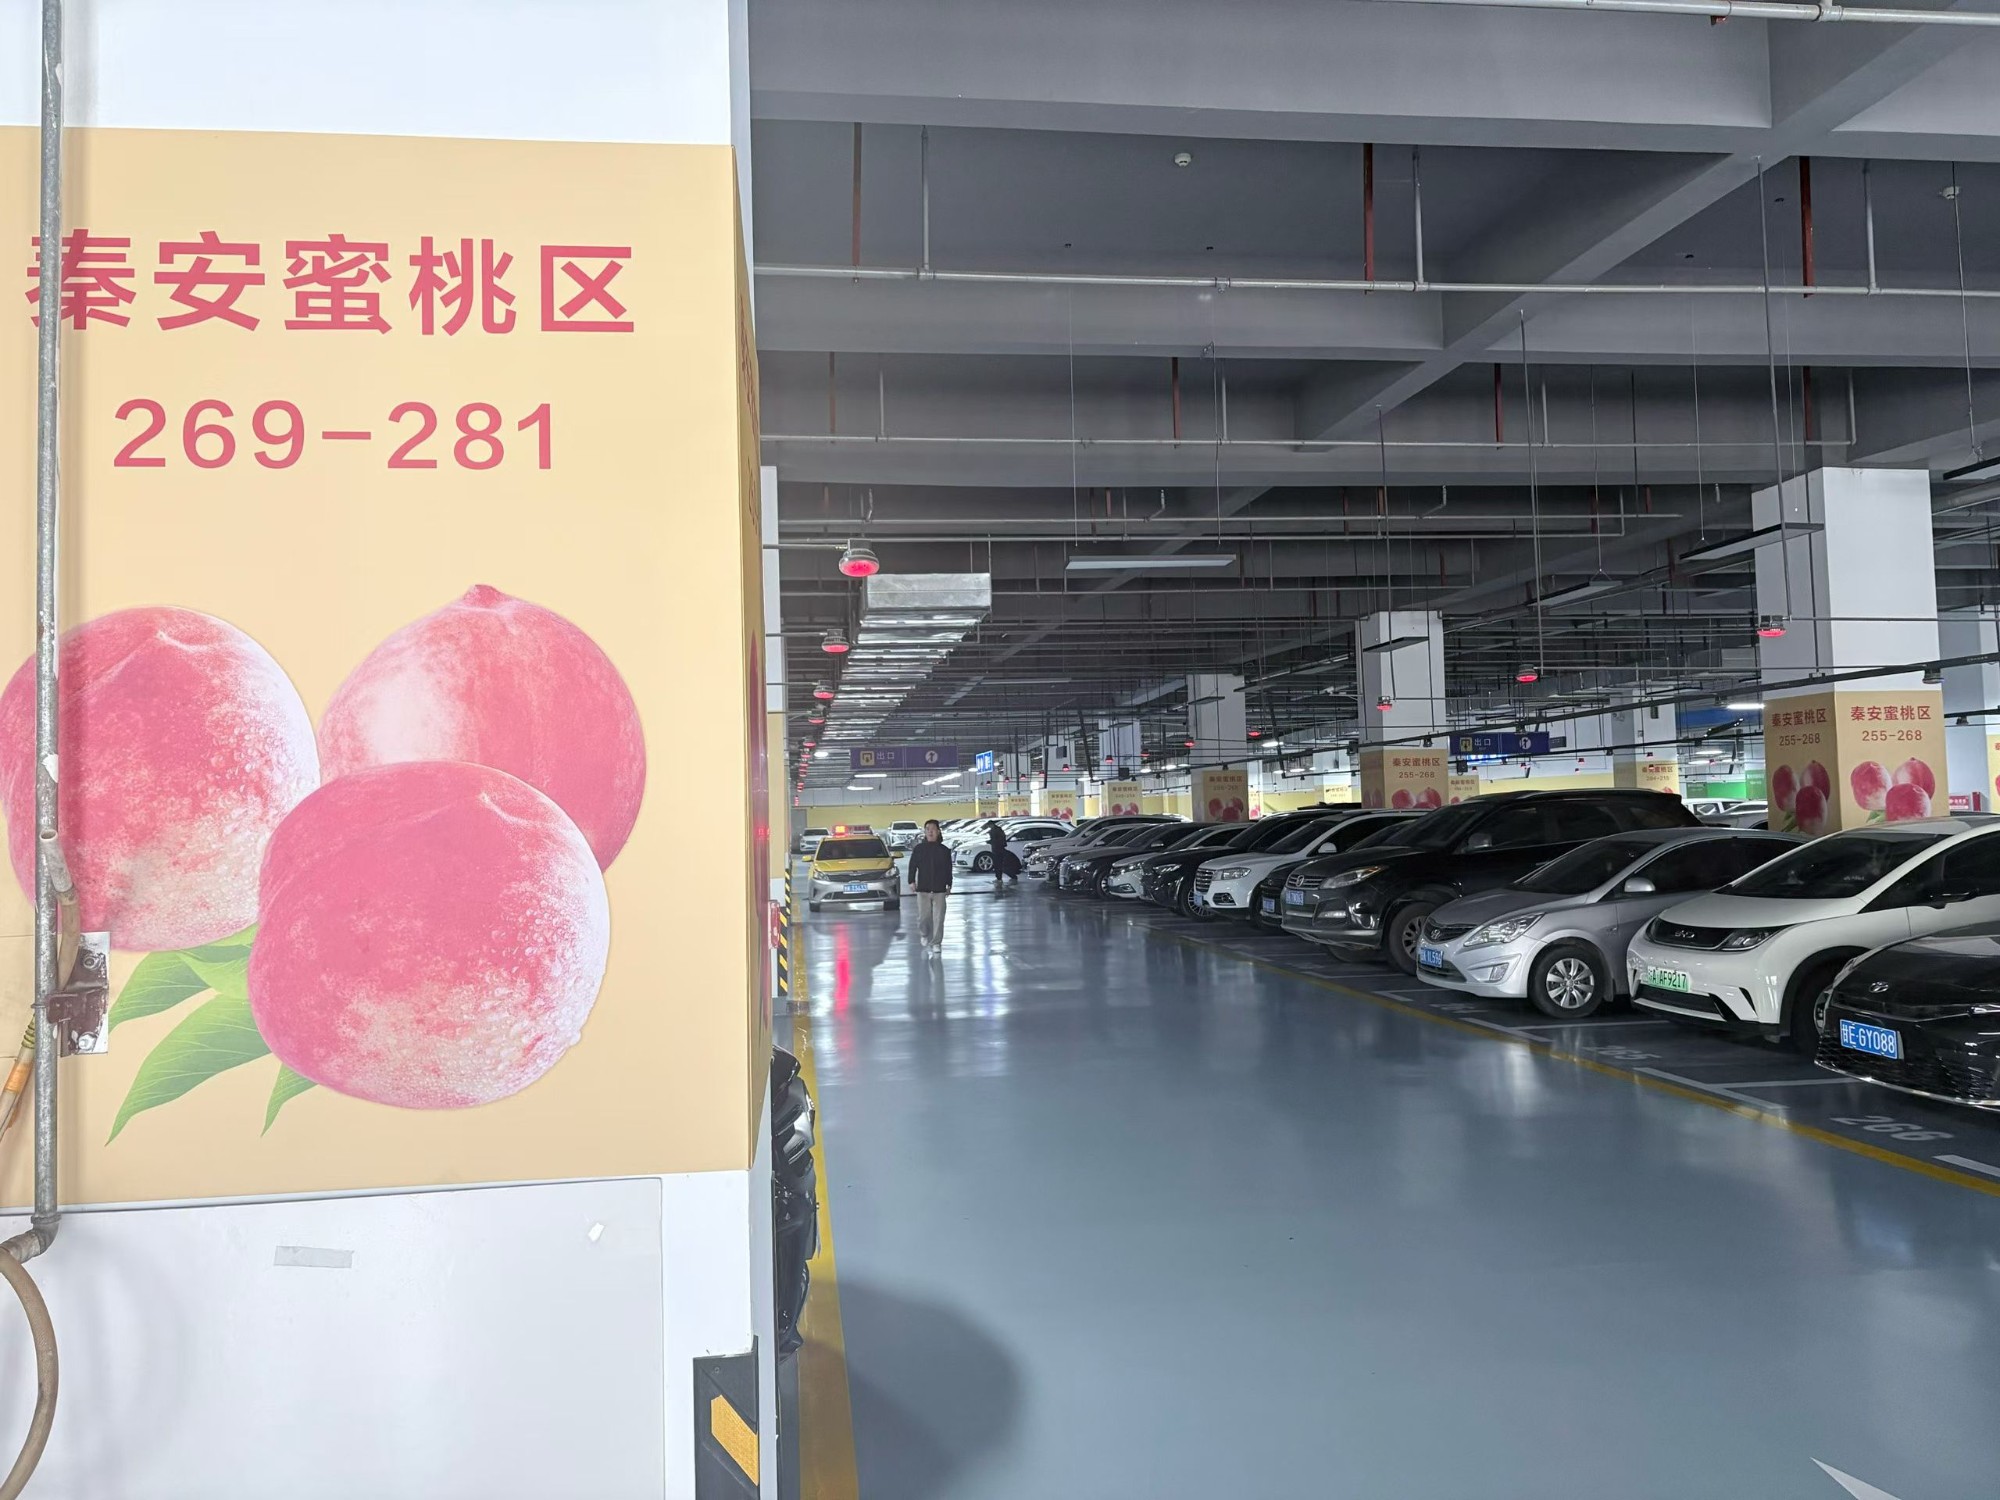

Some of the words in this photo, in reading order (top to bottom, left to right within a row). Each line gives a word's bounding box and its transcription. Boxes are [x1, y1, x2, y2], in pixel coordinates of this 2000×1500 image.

[25, 229, 635, 337] 秦安蜜桃区
[113, 398, 552, 471] 269-281
[1771, 708, 1828, 728] 秦安蜜桃区
[1850, 705, 1932, 722] 秦安蜜桃区
[1474, 737, 1491, 746] 出口
[1779, 732, 1821, 747] 255-268
[1862, 729, 1923, 742] 255-268
[876, 751, 895, 760] 出口
[1392, 757, 1441, 767] 秦安蜜桃区
[1399, 771, 1435, 779] 255-268
[1829, 1115, 1955, 1142] 266
